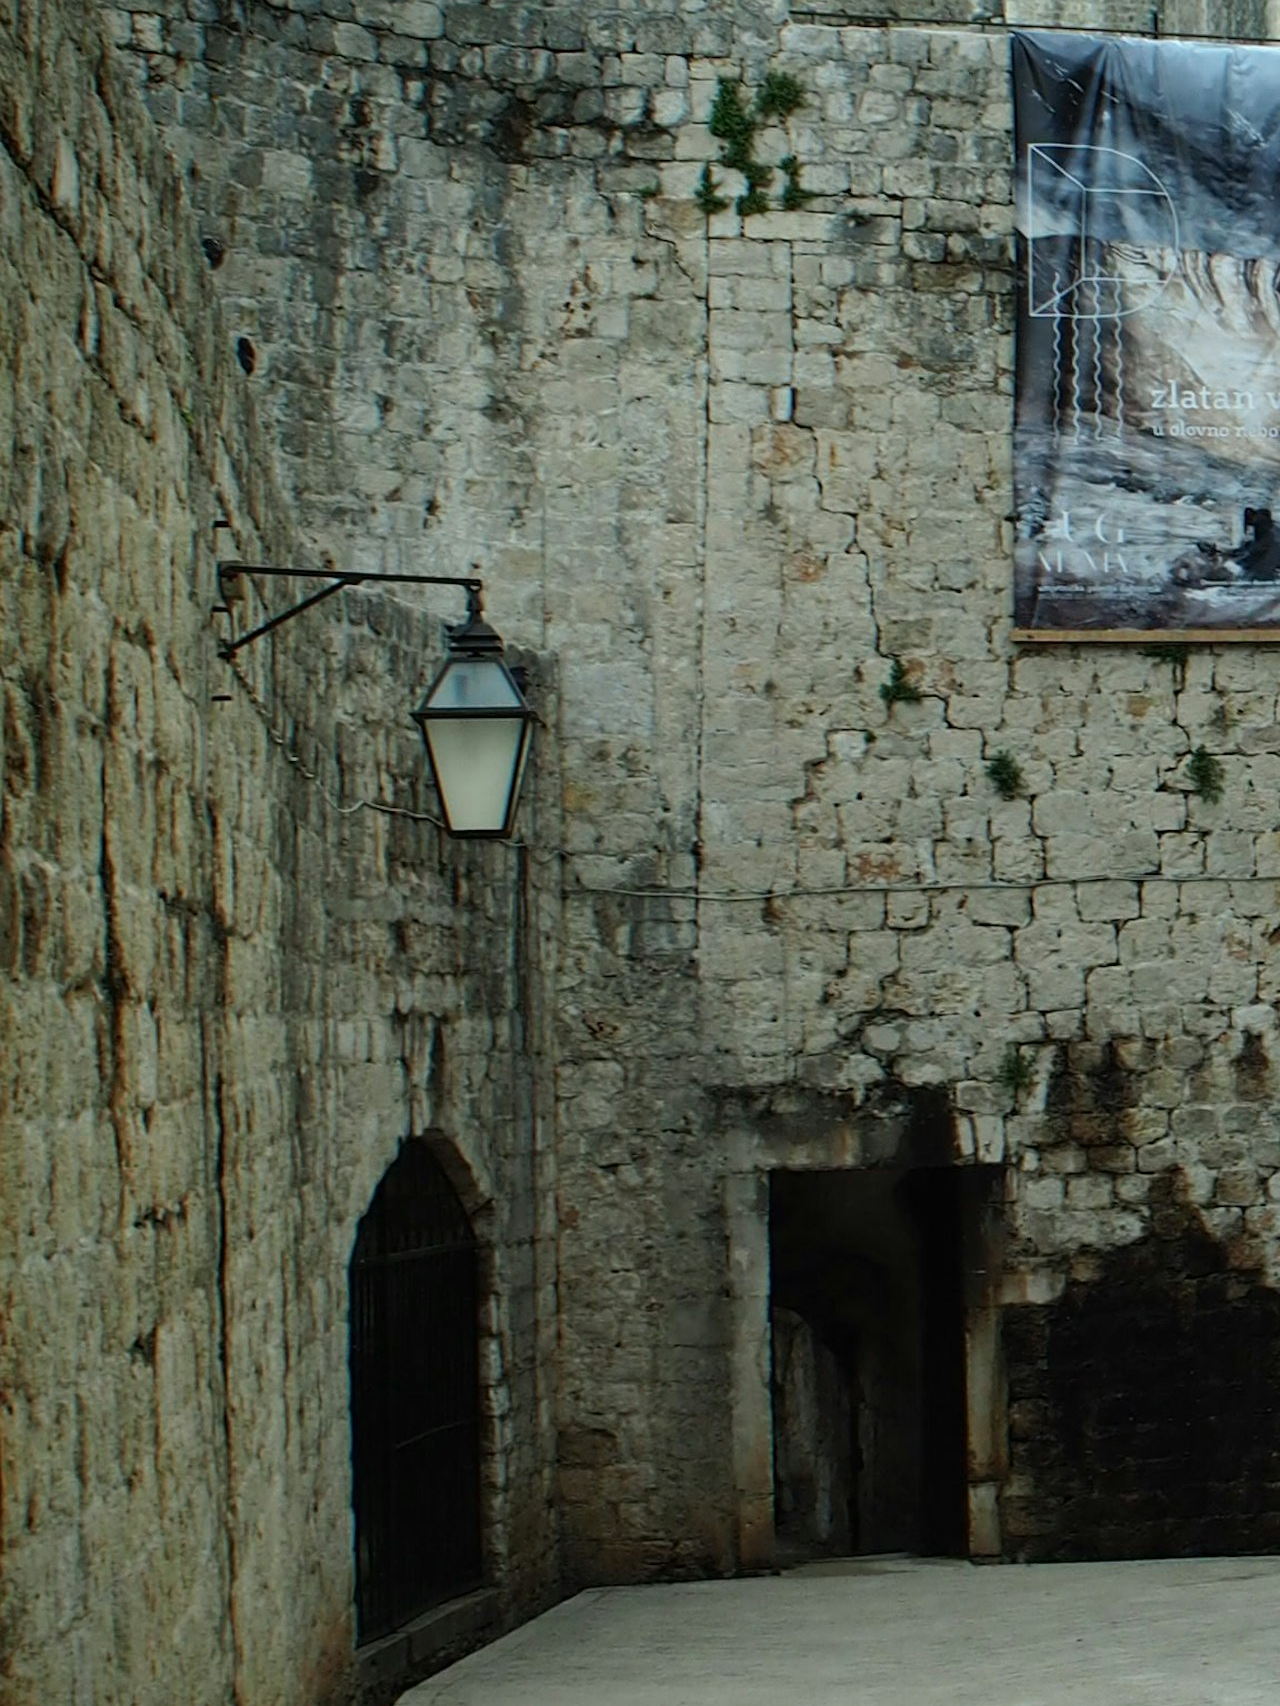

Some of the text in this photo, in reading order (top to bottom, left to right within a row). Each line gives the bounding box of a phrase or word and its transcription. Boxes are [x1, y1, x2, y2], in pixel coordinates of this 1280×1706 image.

[1151, 379, 1257, 410] zlatan
[1151, 424, 1165, 437] u
[1169, 419, 1229, 437] olovno
